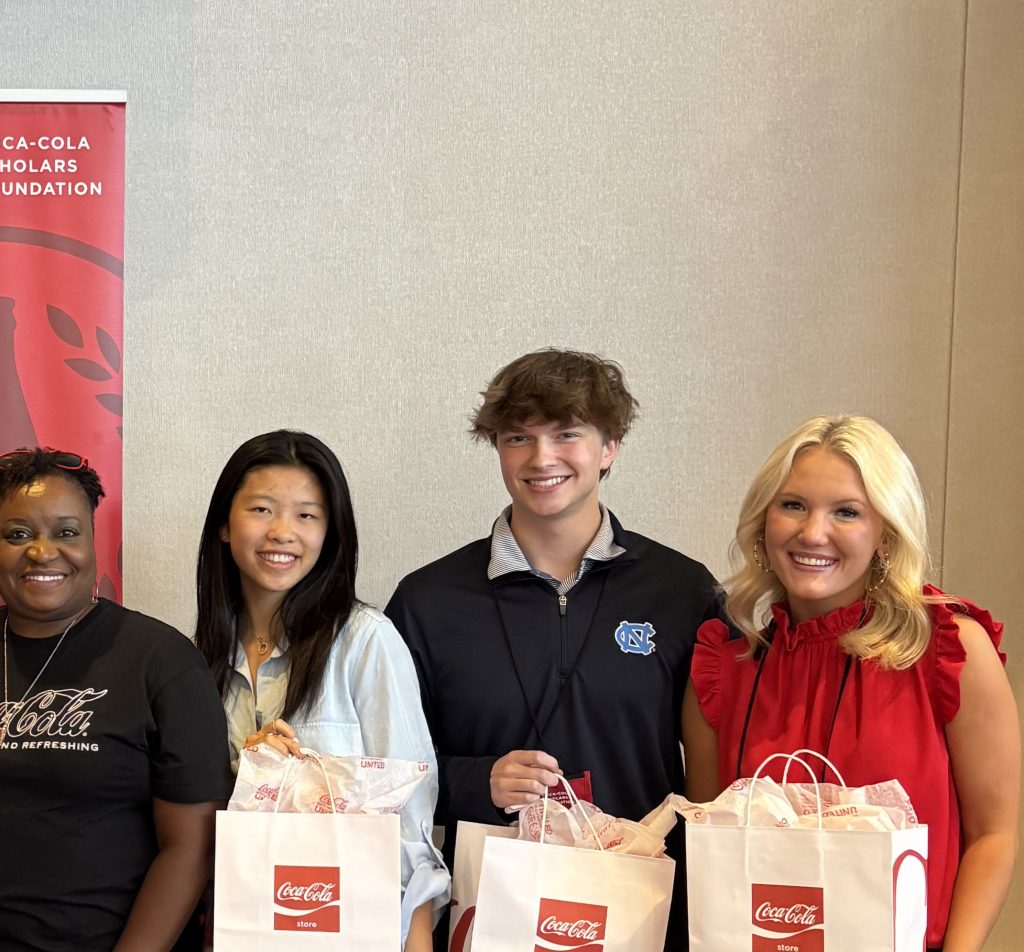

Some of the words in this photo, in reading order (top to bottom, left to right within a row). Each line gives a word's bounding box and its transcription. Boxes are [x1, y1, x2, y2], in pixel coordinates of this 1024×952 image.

[21, 741, 99, 751] REFRESHING
[277, 881, 336, 902] Coca-Cola
[755, 901, 819, 924] Coca-Cola
[296, 920, 318, 928] store
[540, 915, 602, 940] Coca-Cola
[777, 944, 799, 952] store
